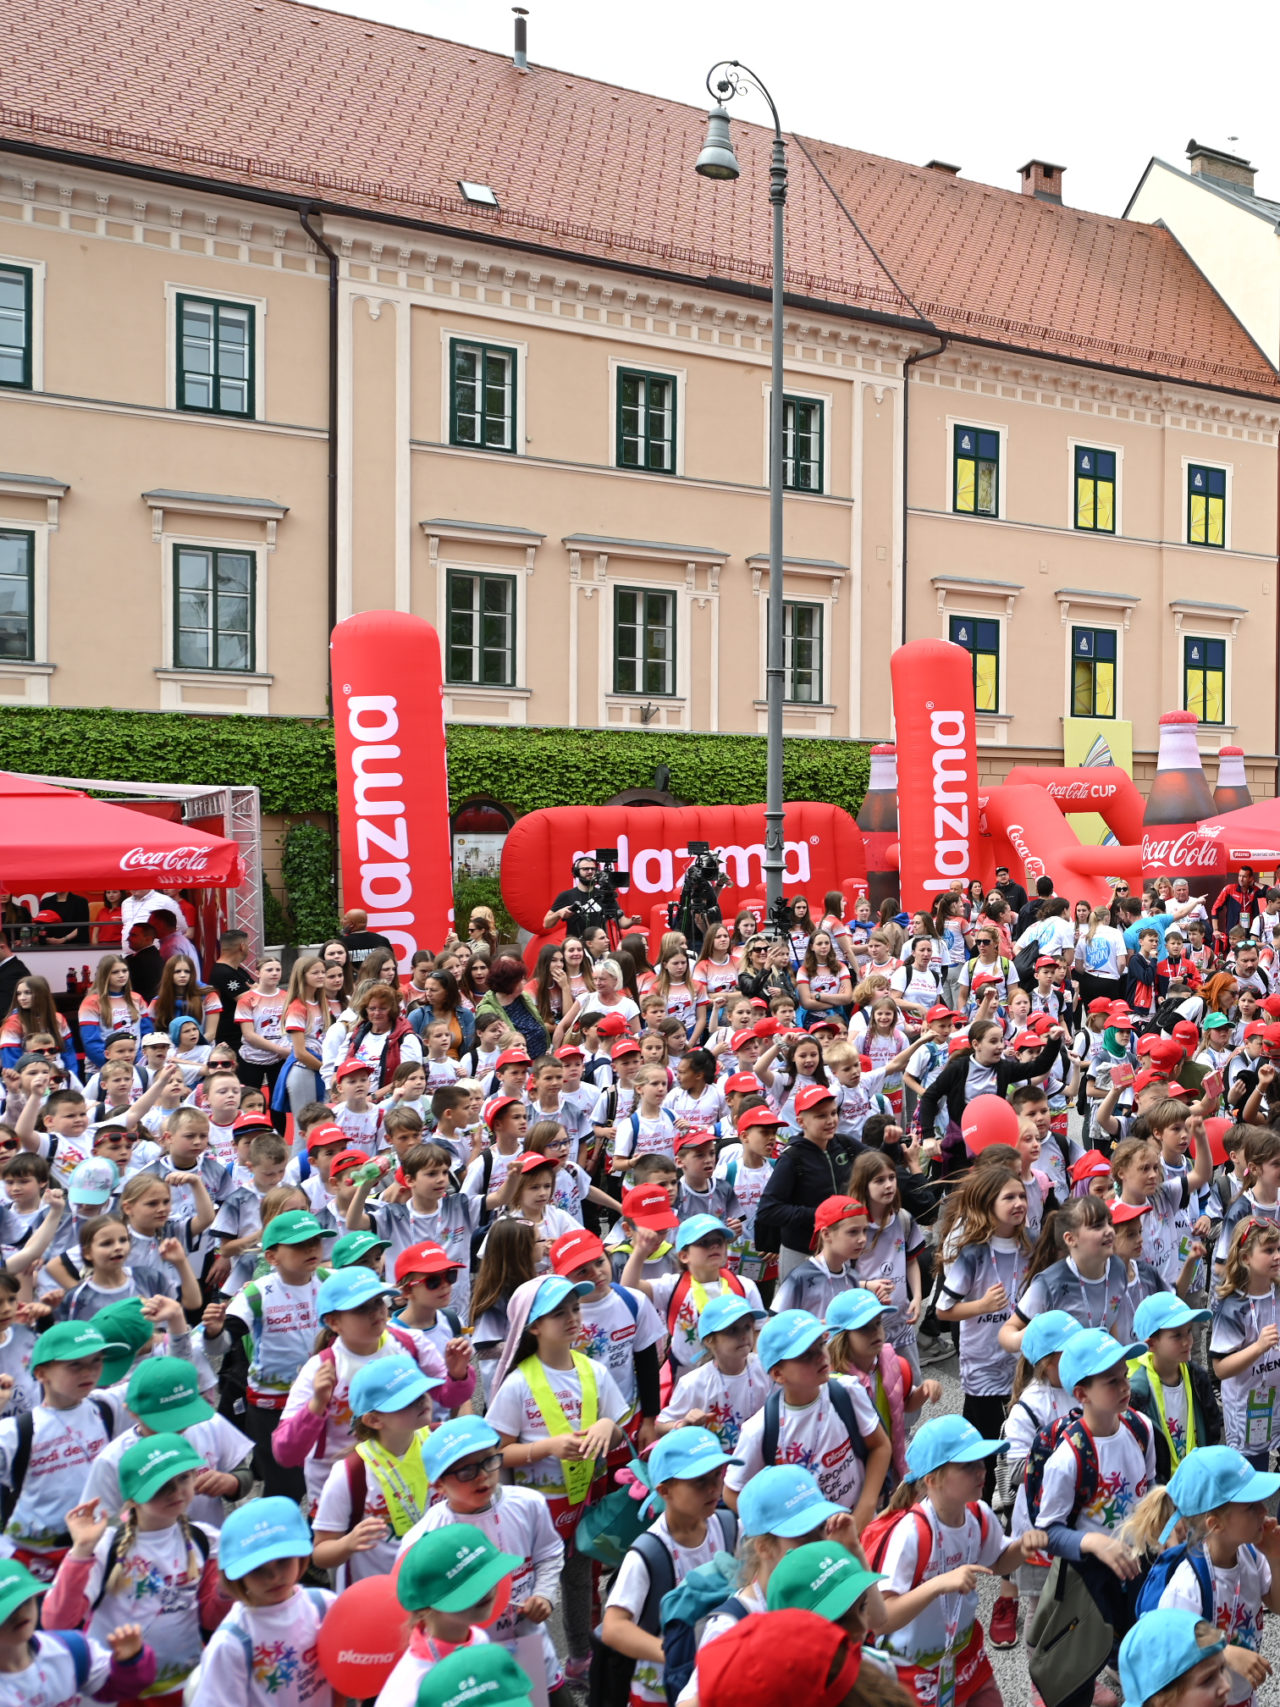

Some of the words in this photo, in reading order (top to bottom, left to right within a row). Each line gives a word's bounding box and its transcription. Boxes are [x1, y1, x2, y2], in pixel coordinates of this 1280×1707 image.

[1091, 784, 1117, 798] CUP
[923, 711, 970, 890] lazma
[119, 846, 214, 872] Coca-Cola
[267, 1314, 291, 1325] bodi
[977, 1311, 1011, 1324] ARENA
[527, 1408, 541, 1419] bo
[337, 1650, 395, 1666] plazma
